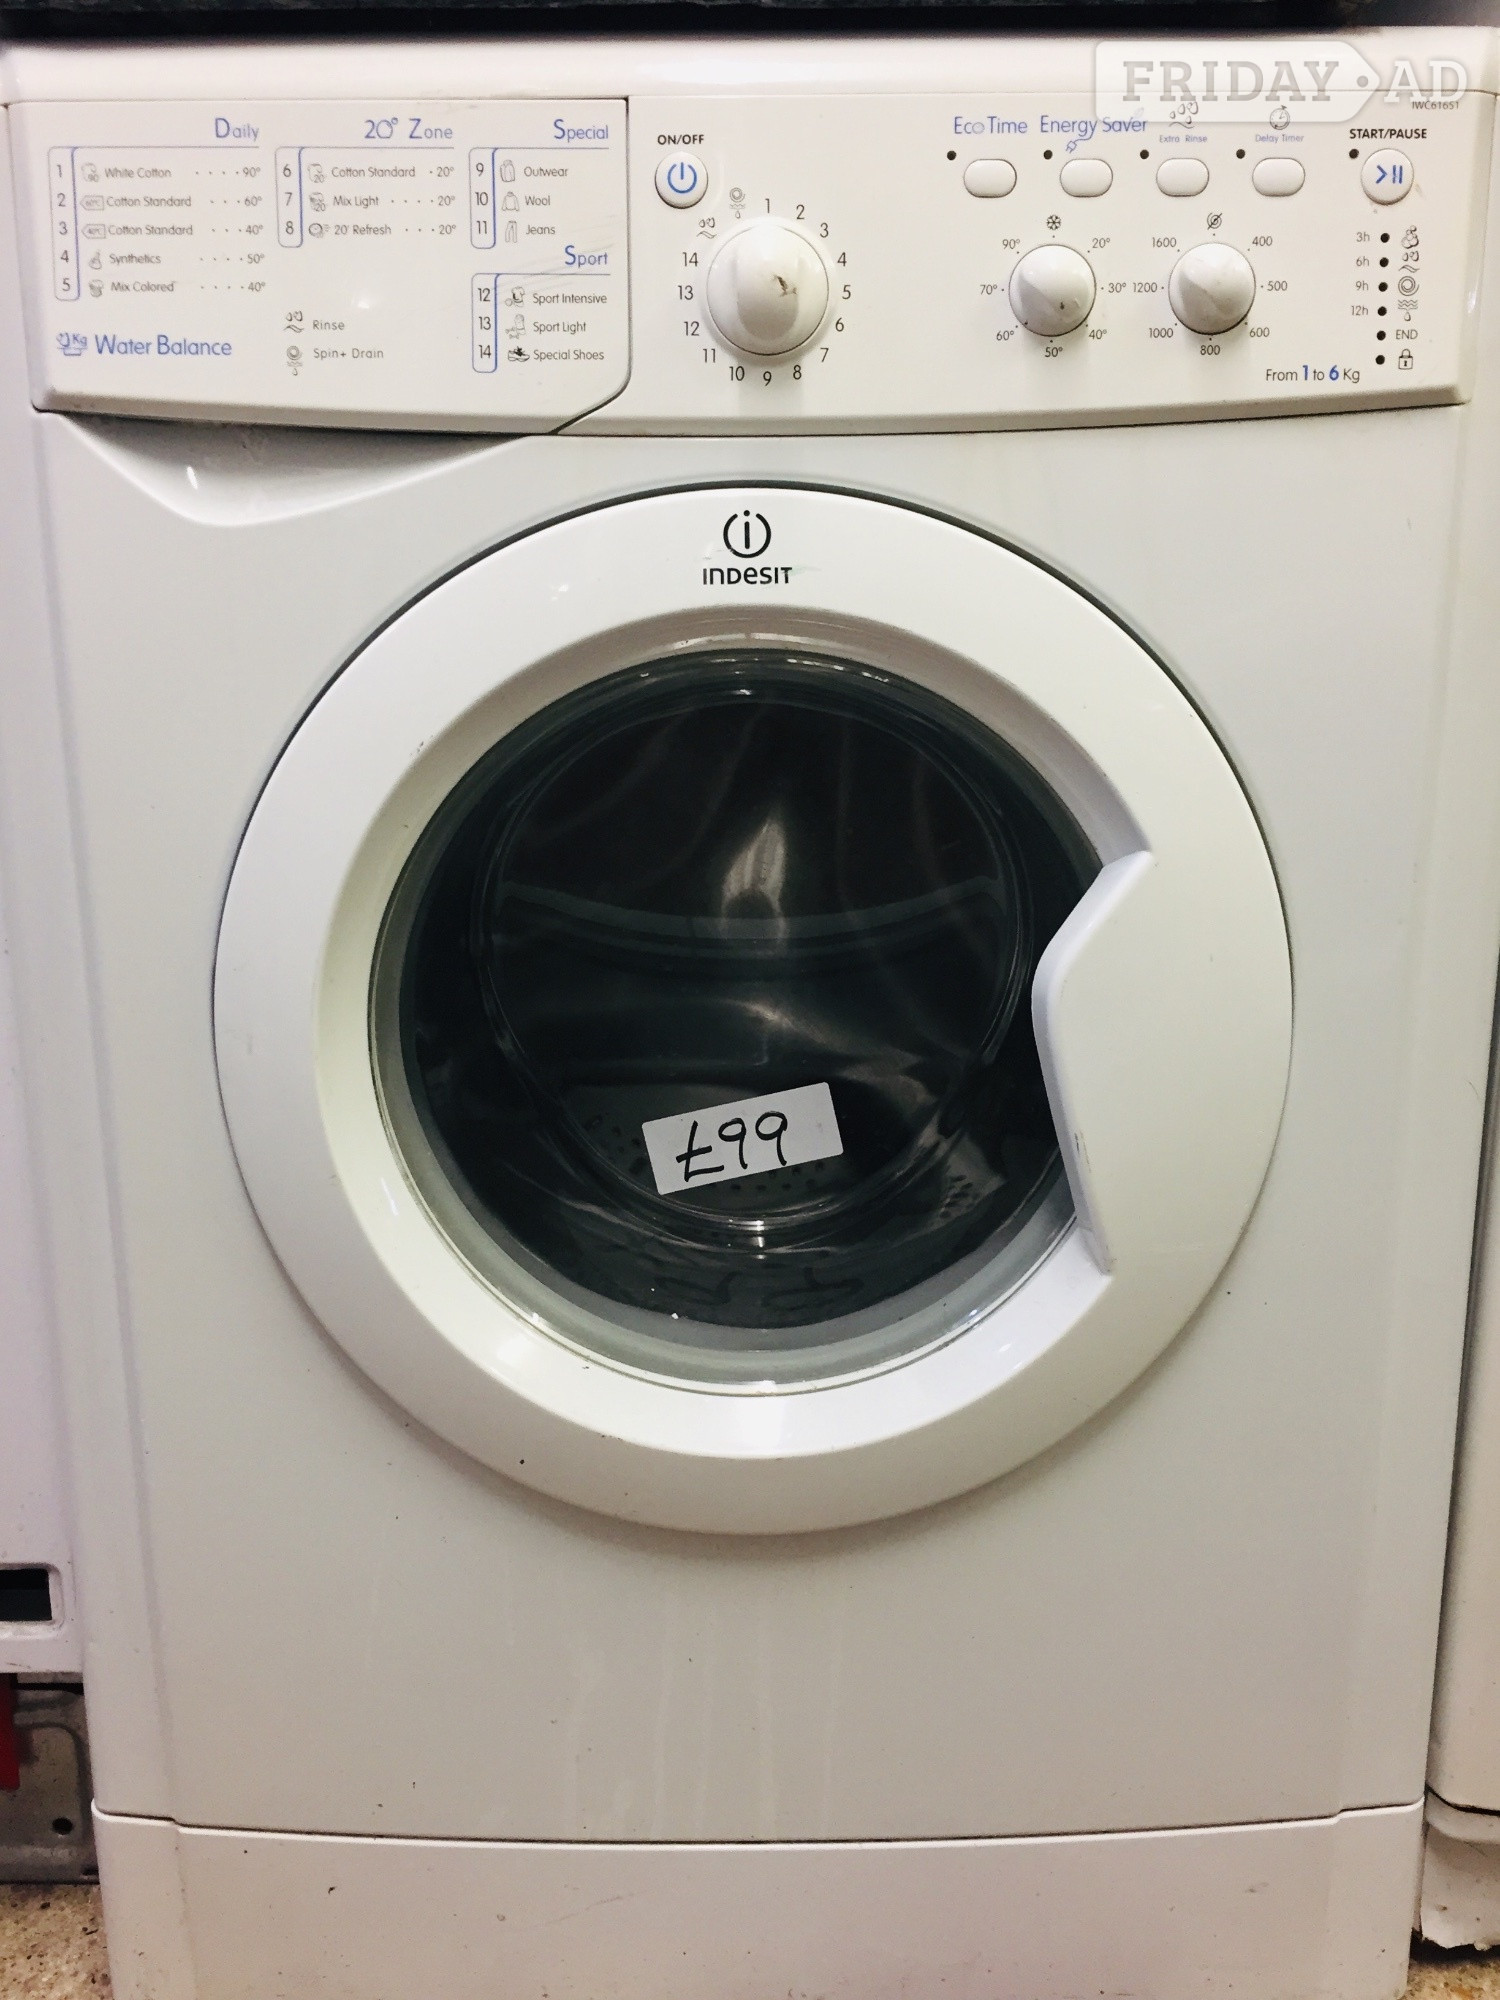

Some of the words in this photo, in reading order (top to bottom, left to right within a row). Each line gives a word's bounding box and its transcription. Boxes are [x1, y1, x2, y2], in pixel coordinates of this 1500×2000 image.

[215, 118, 259, 142] Daily
[365, 117, 398, 139] 20°
[409, 118, 452, 139] Zone
[554, 119, 608, 143] Special
[1040, 115, 1097, 136] Energy
[1103, 117, 1147, 132] Saver
[1159, 135, 1180, 143] Extra
[1185, 135, 1207, 143] Rinse
[1255, 134, 1279, 144] Delay
[1282, 134, 1304, 142] Timer
[1350, 128, 1427, 139] START/PAUSE
[657, 134, 704, 145] ON/OFF
[57, 164, 62, 178] 1
[105, 167, 134, 178] White
[137, 167, 172, 178] Cotton
[242, 167, 261, 178] 90°
[283, 164, 291, 177] 6
[331, 167, 365, 177] Cotton
[368, 166, 415, 177] Standard
[437, 166, 454, 177] 20°
[476, 163, 484, 176] 9
[524, 167, 568, 177] Outwear
[57, 193, 66, 207] 2
[107, 197, 140, 206] Cotton
[143, 196, 191, 207] Standard
[244, 196, 262, 206] 60°
[285, 192, 293, 206] 7
[333, 195, 352, 206] Mix
[355, 196, 378, 209] Light
[438, 195, 455, 206] 20°
[475, 192, 489, 206] 10
[525, 195, 550, 206] Wool
[765, 198, 770, 213] 1
[796, 204, 804, 220] 2
[59, 221, 68, 235] 3
[108, 226, 141, 235] Cotton
[145, 225, 193, 235] Standard
[246, 225, 263, 235] 40°
[286, 221, 294, 235] 8
[352, 224, 391, 235] Refresh
[439, 224, 456, 235] 20°
[476, 221, 487, 234] 11
[526, 225, 555, 235] Jeans
[820, 222, 829, 238] 3
[1152, 237, 1177, 247] 1600
[1252, 236, 1273, 246] 400
[1356, 232, 1370, 242] 3h
[1002, 239, 1020, 250] 90°
[1092, 238, 1110, 248] 20°
[60, 250, 69, 263] 4
[109, 254, 161, 265] Synthetics
[247, 254, 264, 264] 50°
[565, 245, 608, 268] Sport
[683, 252, 698, 267] 14
[837, 252, 847, 267] 4
[1356, 256, 1369, 267] 6h
[62, 278, 70, 291] 5
[111, 282, 130, 292] Mix
[133, 281, 176, 292] Colored
[248, 282, 266, 292] 40°
[980, 284, 997, 295] 70°
[1108, 282, 1126, 293] 30°
[1133, 282, 1157, 293] 1200
[1267, 281, 1287, 291] 500
[1356, 280, 1368, 290] 9h
[478, 288, 490, 302] 12
[678, 285, 693, 300] 13
[842, 285, 851, 300] 5
[533, 294, 559, 305] Sport
[562, 294, 607, 304] Intensive
[1351, 305, 1368, 316] 12h
[313, 320, 345, 330] Rinse
[479, 316, 491, 330] 13
[533, 322, 560, 333] Sport
[563, 321, 586, 335] Light
[684, 321, 699, 336] 12
[835, 318, 844, 332] 6
[996, 330, 1014, 341] 60°
[1089, 329, 1107, 339] 40°
[1149, 328, 1173, 338] 1000
[1249, 327, 1270, 337] 600
[1396, 329, 1418, 340] END
[95, 334, 152, 355] Water
[157, 335, 232, 355] Balance
[1200, 345, 1220, 355] 800
[314, 348, 346, 360] Spin+
[352, 348, 383, 358] Drain
[479, 345, 491, 358] 14
[534, 349, 570, 362] Special
[573, 349, 604, 360] Shoes
[703, 348, 715, 363] 11
[820, 347, 829, 362] 7
[1044, 347, 1063, 357] 50°
[729, 366, 745, 381] 10
[792, 365, 802, 380] 8
[1266, 369, 1298, 381] From
[1303, 365, 1308, 381] 1
[1313, 369, 1324, 381] to
[1329, 365, 1339, 381] 6
[1343, 368, 1360, 384] Kg
[763, 371, 772, 386] 9
[675, 1111, 788, 1182] £99
